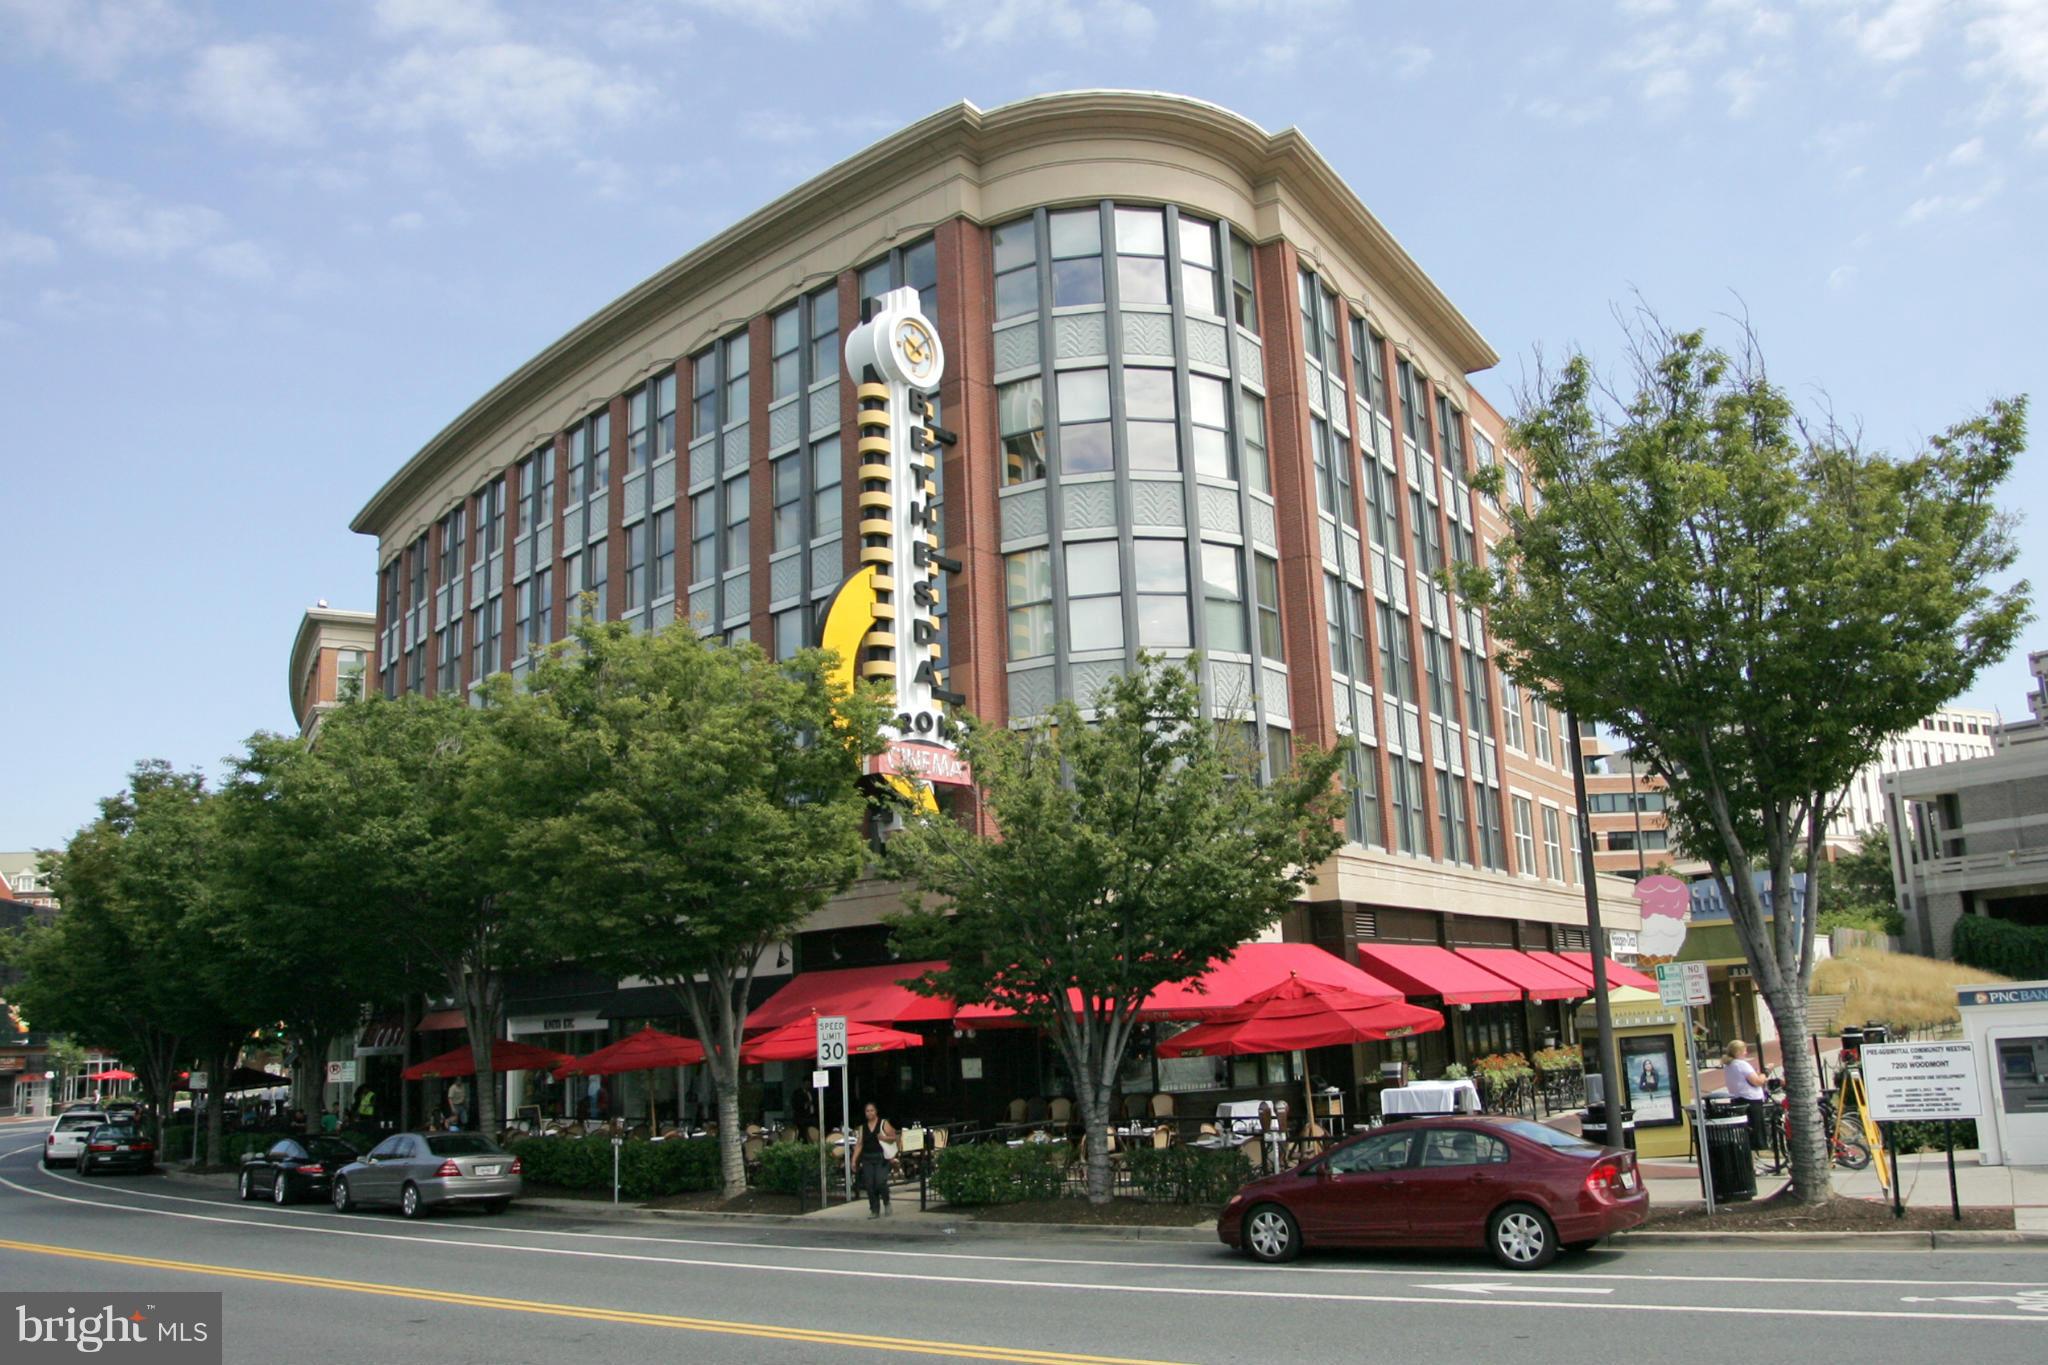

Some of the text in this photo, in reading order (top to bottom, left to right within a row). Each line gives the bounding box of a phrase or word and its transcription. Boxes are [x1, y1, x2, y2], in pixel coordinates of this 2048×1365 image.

[909, 388, 941, 688] BETHESDA
[887, 746, 963, 778] CINEMA
[1687, 965, 1700, 974] NO
[1989, 991, 2020, 1003] PNC
[819, 1022, 844, 1031] SPEED
[822, 1032, 841, 1041] LIMIT
[821, 1042, 844, 1060] 30
[1891, 1060, 1949, 1070] 7200 WOODMONT
